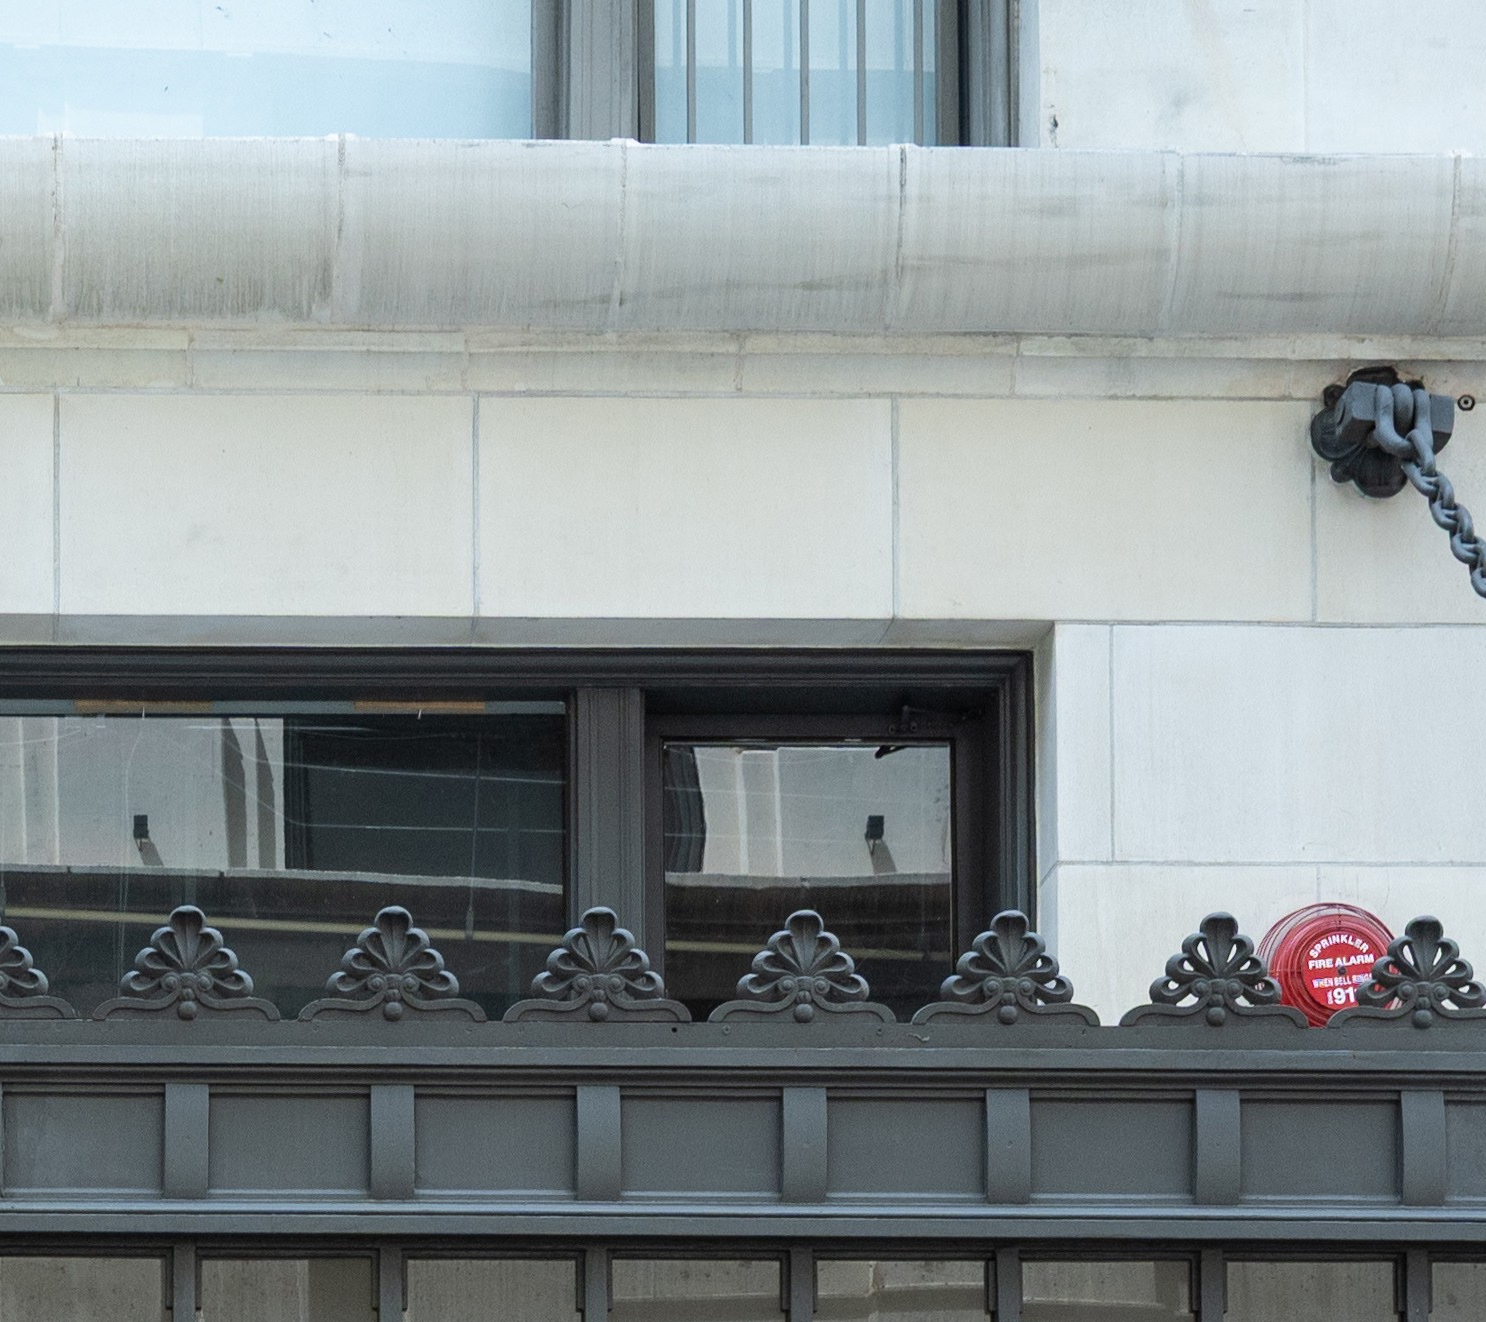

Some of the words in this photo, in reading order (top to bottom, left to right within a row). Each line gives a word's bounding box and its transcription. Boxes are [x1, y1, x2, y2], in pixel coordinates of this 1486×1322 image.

[1309, 934, 1369, 958] SPRINKLER
[1308, 958, 1334, 970] FIRE
[1335, 954, 1375, 967] ALARM
[1312, 978, 1333, 988] WHEN
[1334, 976, 1351, 986] BELL
[1333, 986, 1357, 1005] 91
